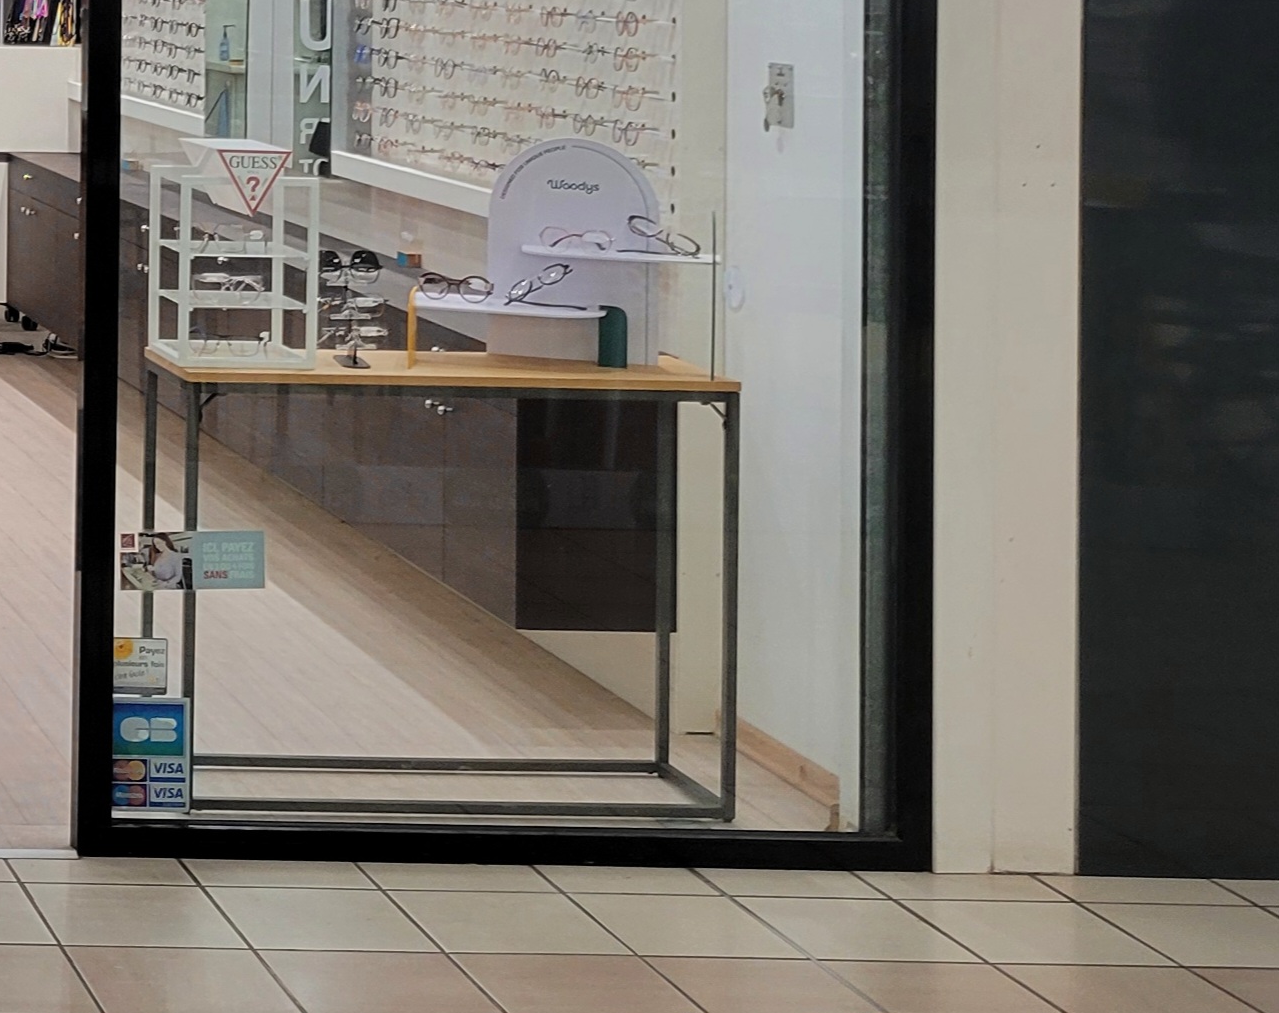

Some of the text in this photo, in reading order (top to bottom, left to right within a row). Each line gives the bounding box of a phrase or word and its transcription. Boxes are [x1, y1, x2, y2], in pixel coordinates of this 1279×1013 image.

[229, 155, 277, 169] GUESS
[547, 179, 600, 194] Woodys
[203, 571, 228, 579] SANS
[139, 646, 165, 656] Payez
[154, 762, 185, 774] VISA
[154, 787, 184, 799] VISA
